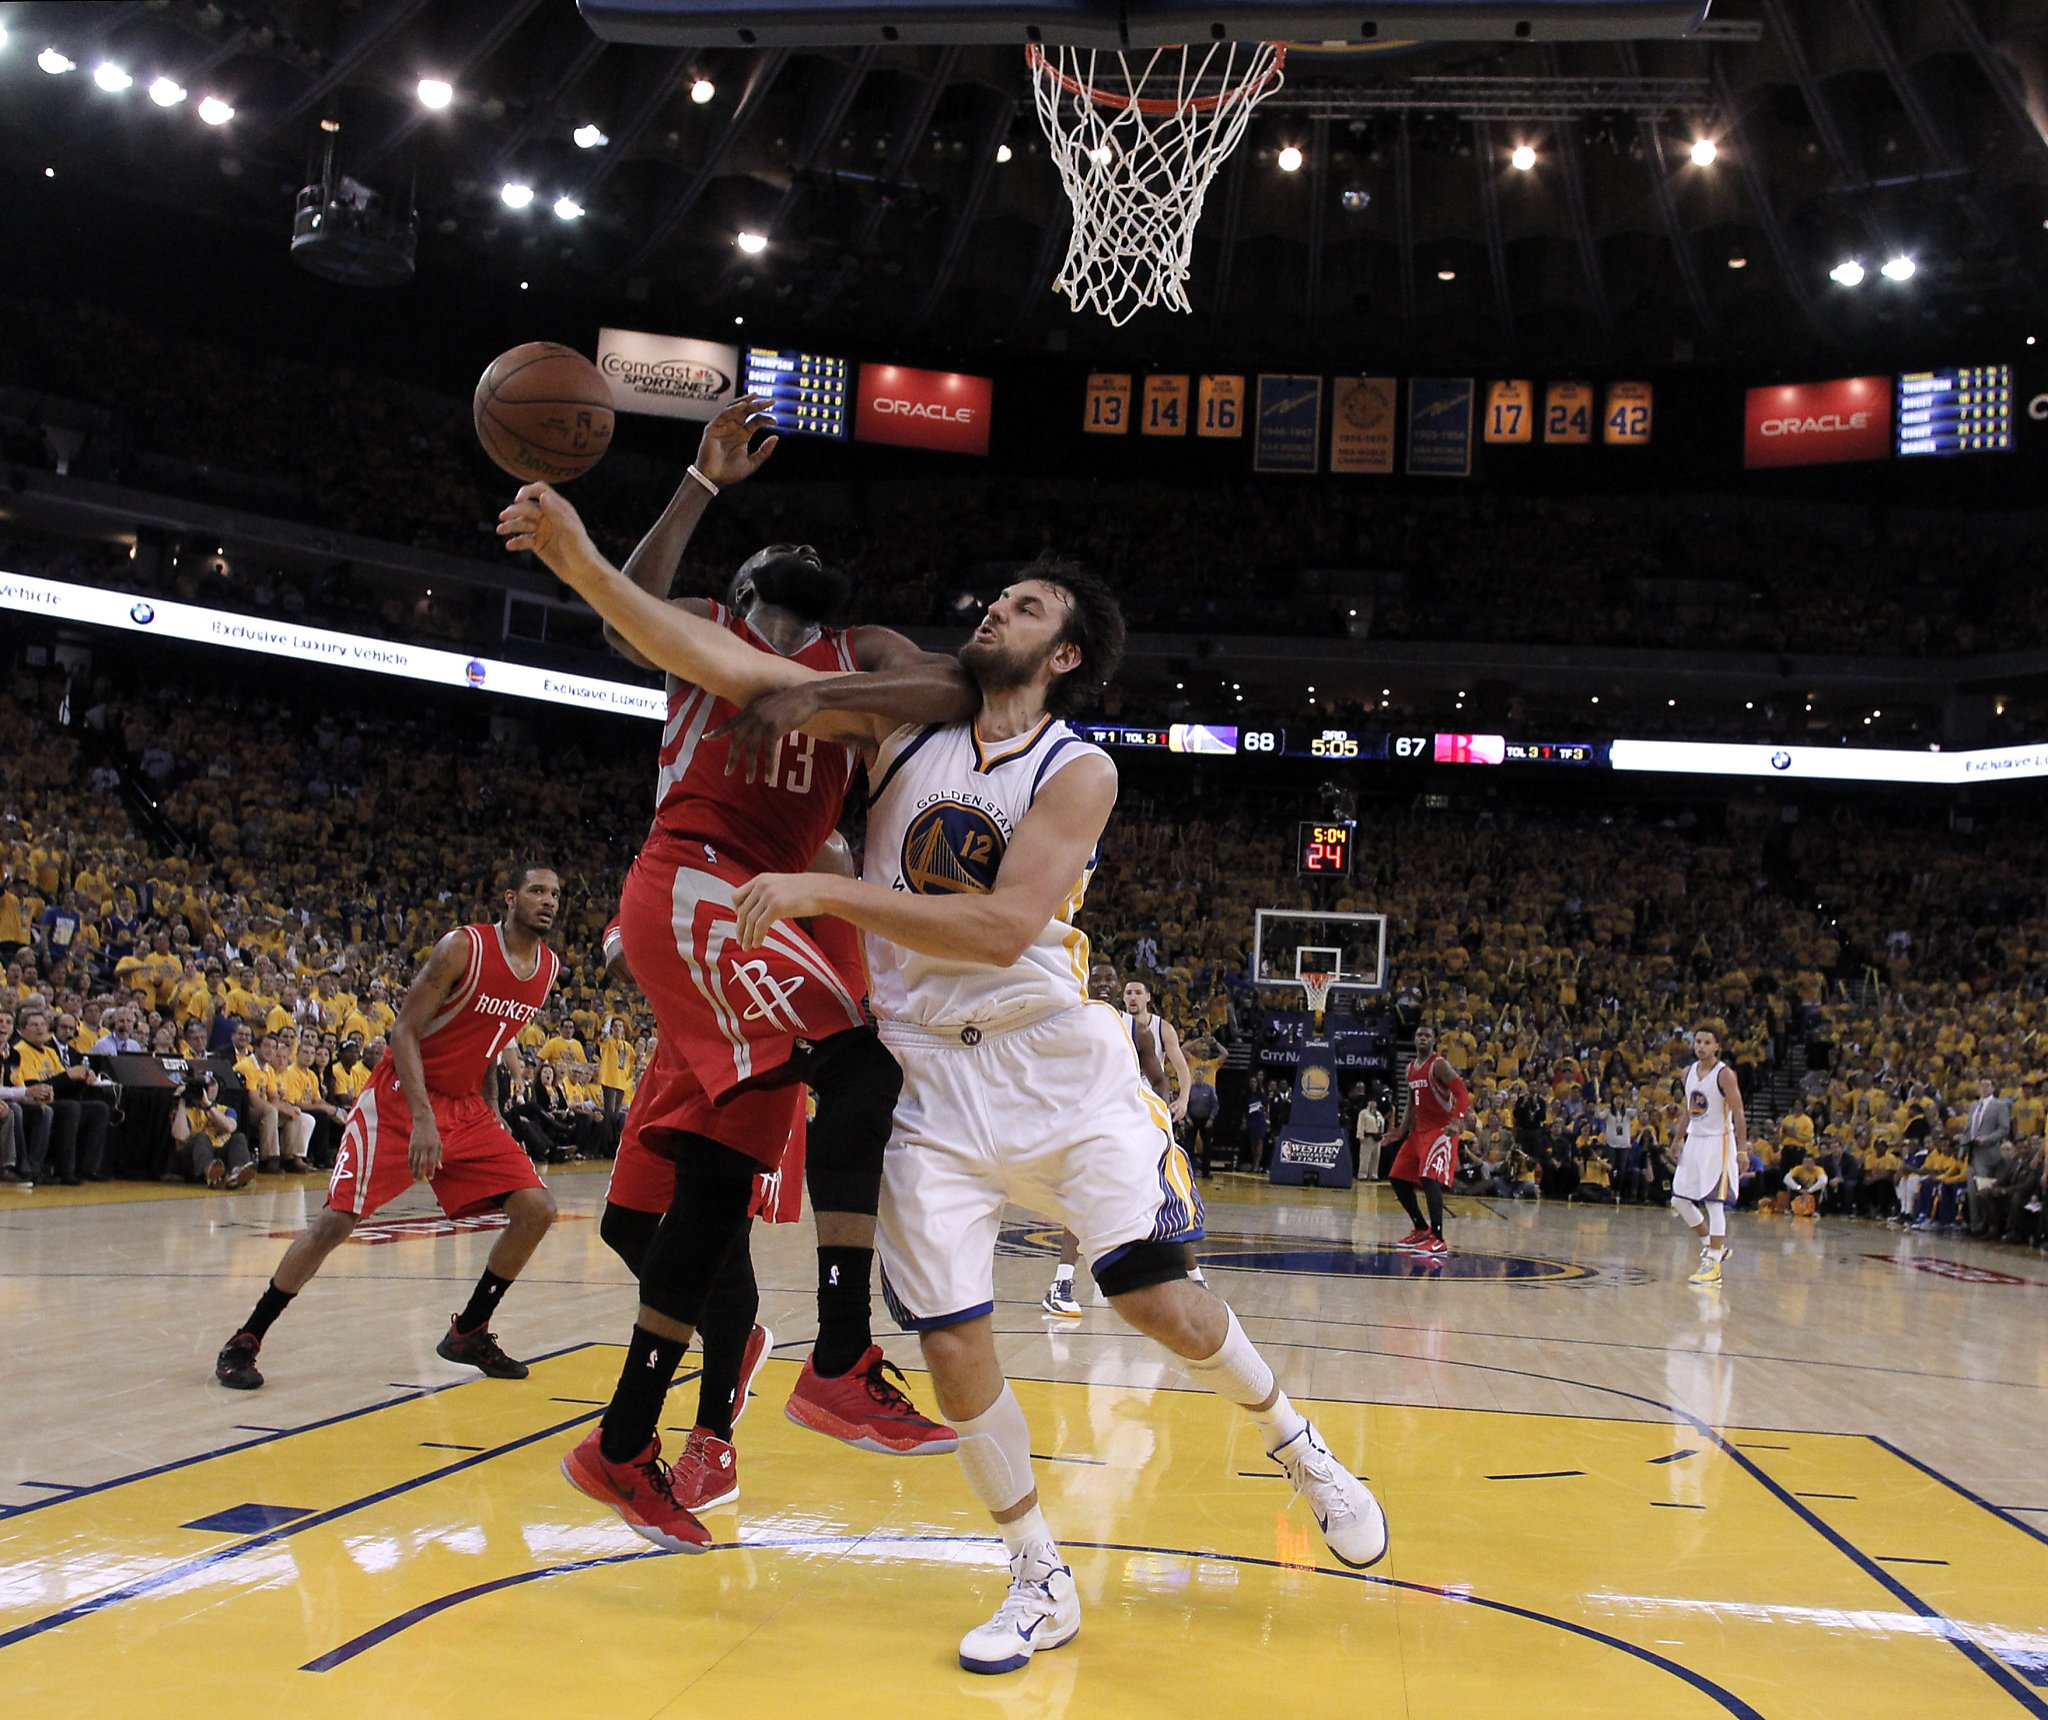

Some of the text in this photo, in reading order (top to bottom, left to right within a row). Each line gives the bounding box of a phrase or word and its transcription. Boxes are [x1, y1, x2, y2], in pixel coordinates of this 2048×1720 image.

[623, 373, 715, 394] SPORTSNET
[873, 397, 972, 423] ORACLE
[1092, 396, 1122, 425] 13
[1150, 397, 1179, 427] 14
[1205, 398, 1236, 429] 16
[1494, 404, 1523, 435] 17
[1550, 404, 1588, 435] 24
[1609, 405, 1649, 436] 42
[1760, 411, 1868, 436] ORACLE
[611, 692, 658, 711] Luxury
[1092, 731, 1168, 744] TF 1 TOL 3 1
[1243, 732, 1275, 752] 68
[1311, 739, 1359, 757] 5:05
[1321, 730, 1348, 741] 3RD
[1395, 737, 1427, 757] 67
[1506, 747, 1584, 760] TOL 3 1 TF 3
[916, 790, 1014, 842] GOLDEN STAT
[960, 830, 994, 865] 12
[1313, 827, 1347, 843] 5:04
[1307, 843, 1343, 870] 24
[474, 992, 539, 1023] ROCKETS
[485, 1021, 507, 1059] 1
[161, 1057, 189, 1071] ESPN
[1291, 1143, 1340, 1154] WESTERN
